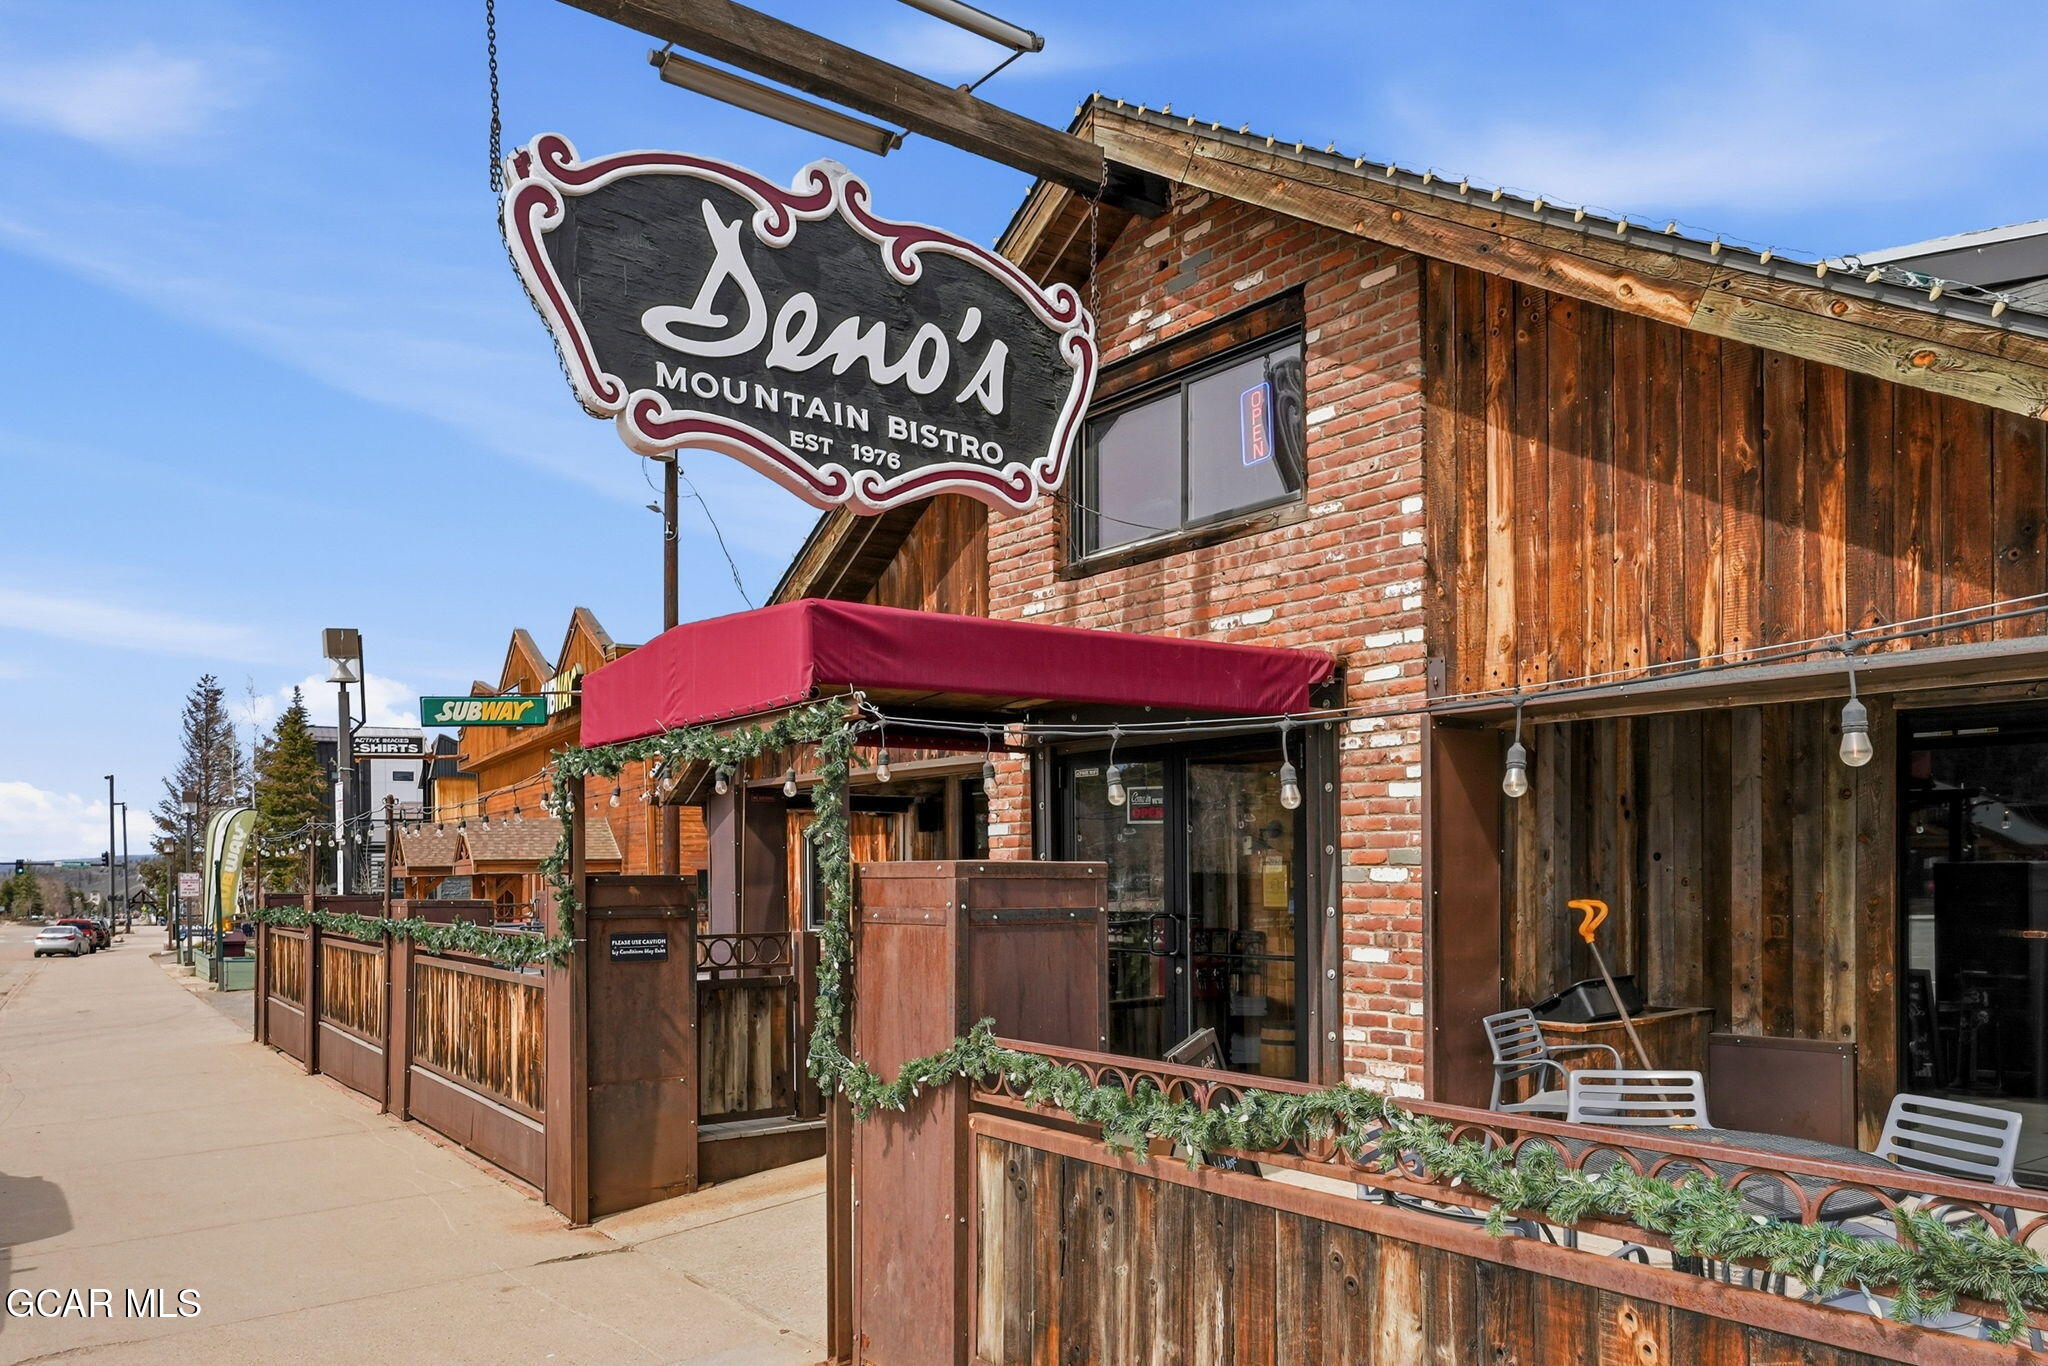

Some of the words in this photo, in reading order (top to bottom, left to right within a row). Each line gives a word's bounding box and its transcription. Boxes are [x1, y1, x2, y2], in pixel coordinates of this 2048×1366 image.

[641, 198, 1009, 416] Deno's
[655, 361, 870, 432] MOUNTAIN
[887, 414, 1005, 465] BISTRO
[1250, 390, 1264, 460] OPEN
[790, 430, 834, 456] EST
[851, 443, 902, 471] 1976
[434, 699, 535, 723] SUBWAY
[540, 664, 583, 716] UBWAY
[353, 743, 419, 753] -SHIRTS
